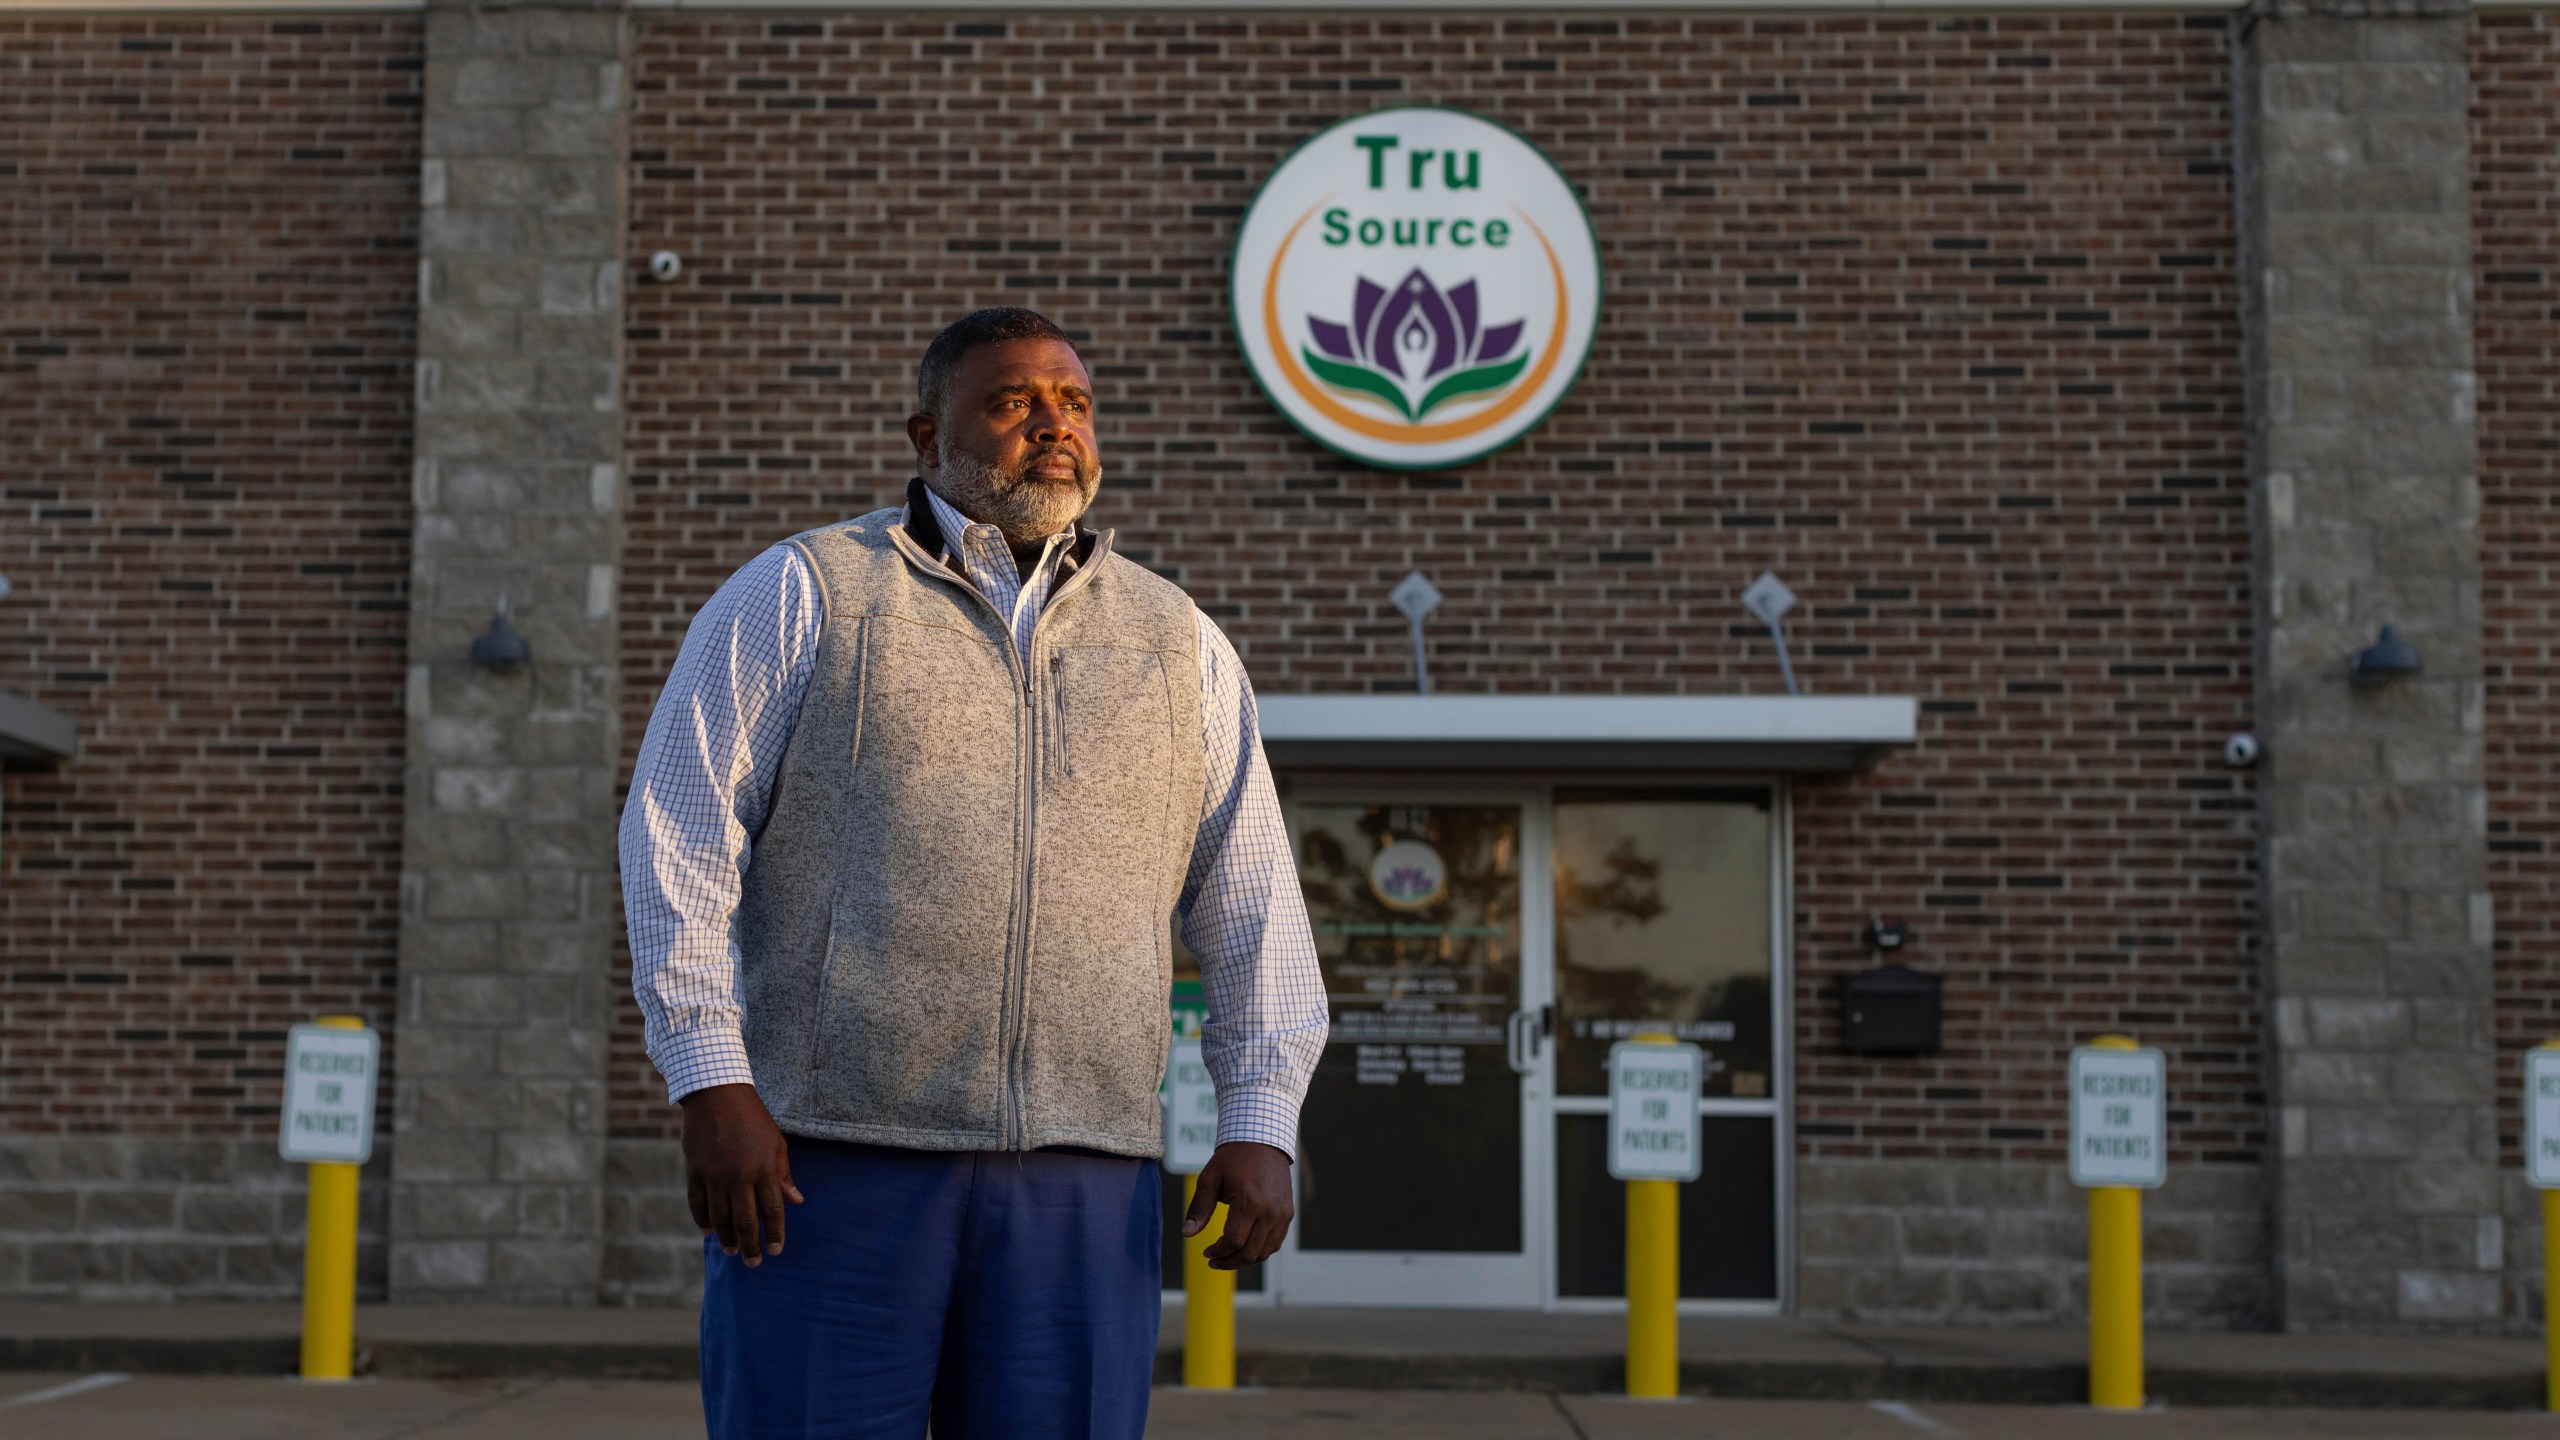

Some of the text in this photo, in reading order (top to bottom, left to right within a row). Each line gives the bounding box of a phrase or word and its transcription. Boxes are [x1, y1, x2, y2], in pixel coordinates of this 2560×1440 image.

[1354, 135, 1480, 190] Tru
[1323, 208, 1511, 247] Source
[300, 1053, 365, 1077] RESERVED
[1622, 1067, 1689, 1092] RESERVED
[2083, 1073, 2152, 1098] RESERVED
[316, 1081, 342, 1105] FOR
[1641, 1098, 1669, 1121] FOR
[2104, 1104, 2132, 1128] FOR
[296, 1111, 359, 1137] PATIENTS
[1623, 1128, 1686, 1154] PATIENTS
[2084, 1133, 2151, 1160] PATIENTS
